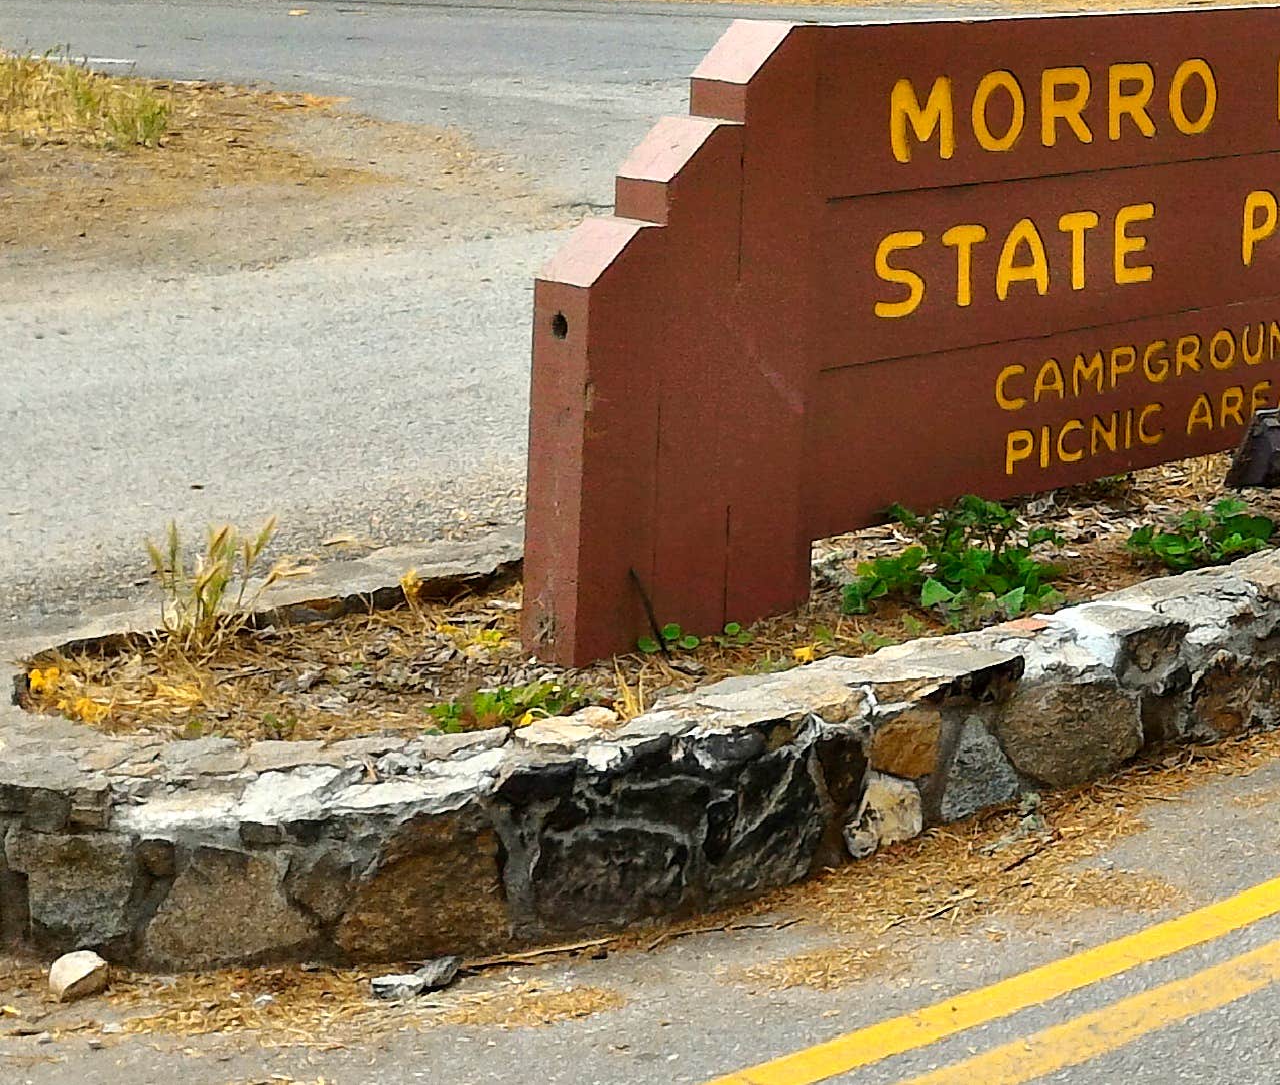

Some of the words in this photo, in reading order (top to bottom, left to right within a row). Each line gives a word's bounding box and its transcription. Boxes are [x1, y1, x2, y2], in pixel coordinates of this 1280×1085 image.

[889, 58, 1218, 163] MORRO
[874, 202, 1156, 318] STATE
[1005, 403, 1165, 476] PICNIC
